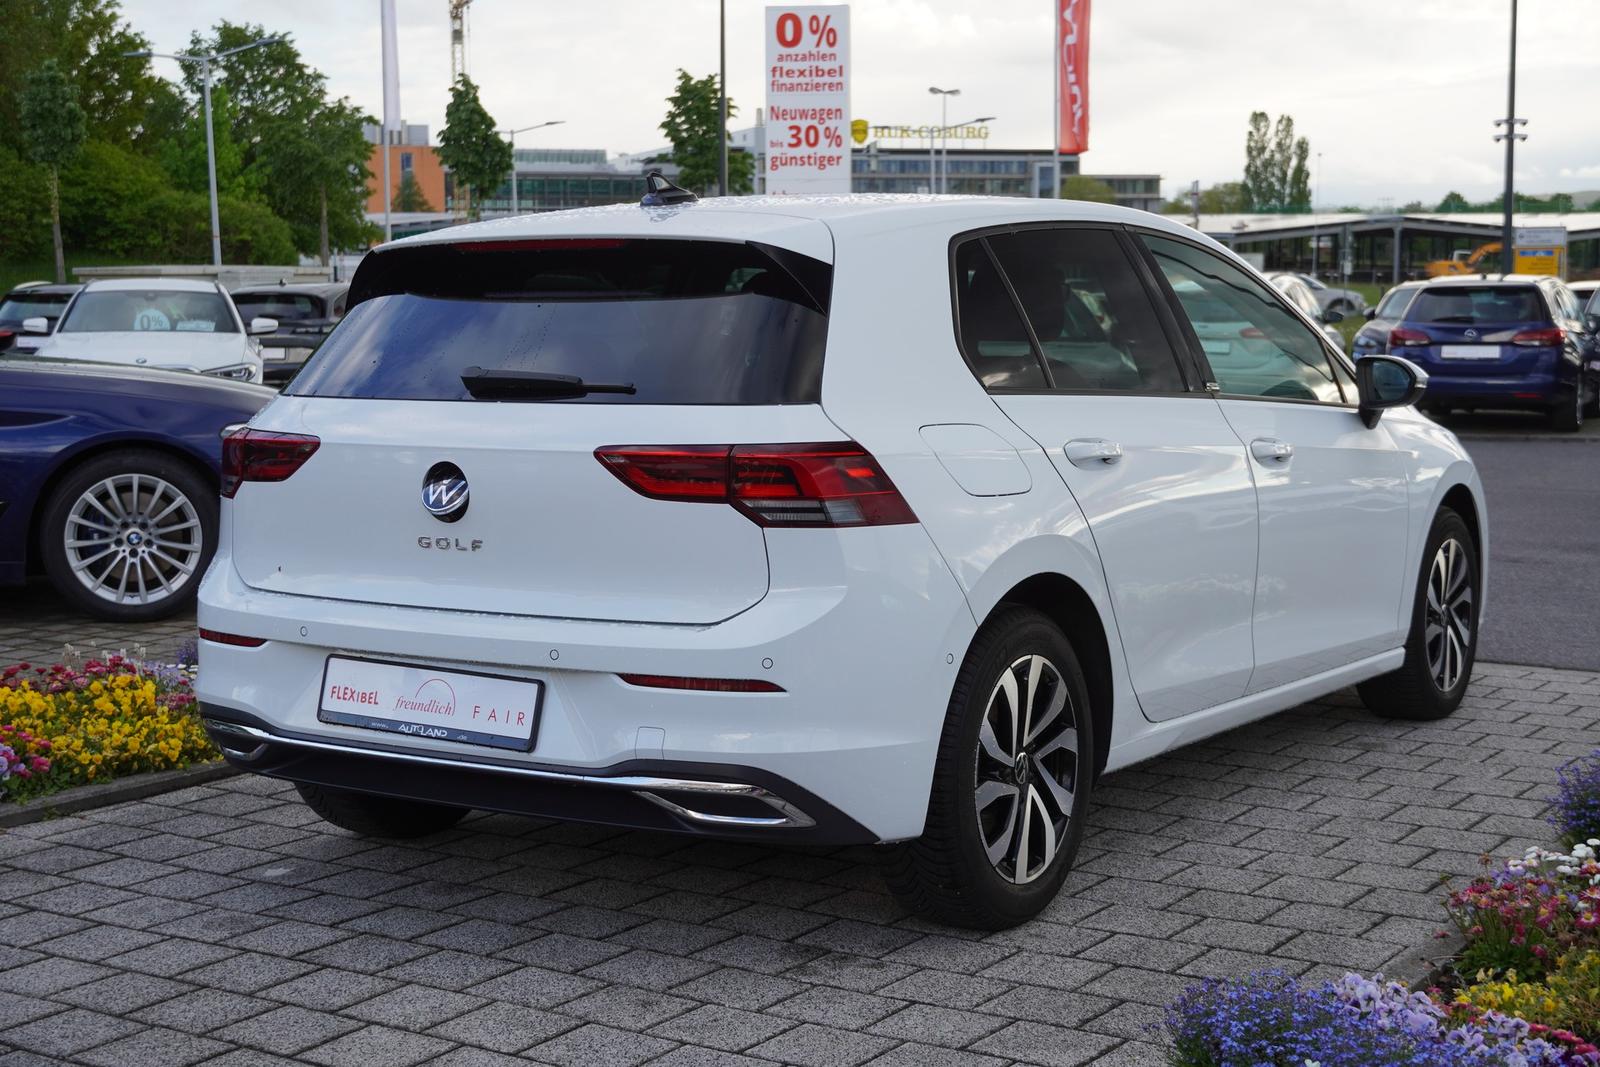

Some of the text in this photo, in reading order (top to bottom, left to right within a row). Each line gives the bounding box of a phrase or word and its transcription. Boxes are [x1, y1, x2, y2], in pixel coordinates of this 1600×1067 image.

[777, 51, 837, 62] anzahlen
[771, 65, 843, 78] flexibel
[771, 80, 843, 92] finanzieren
[770, 106, 843, 125] Neuwagen
[770, 153, 842, 171] günstiger
[418, 536, 483, 552] GOLF
[331, 685, 525, 726] FLEXIBEL freundlich FAIR
[399, 723, 448, 738] AUTOLAND
